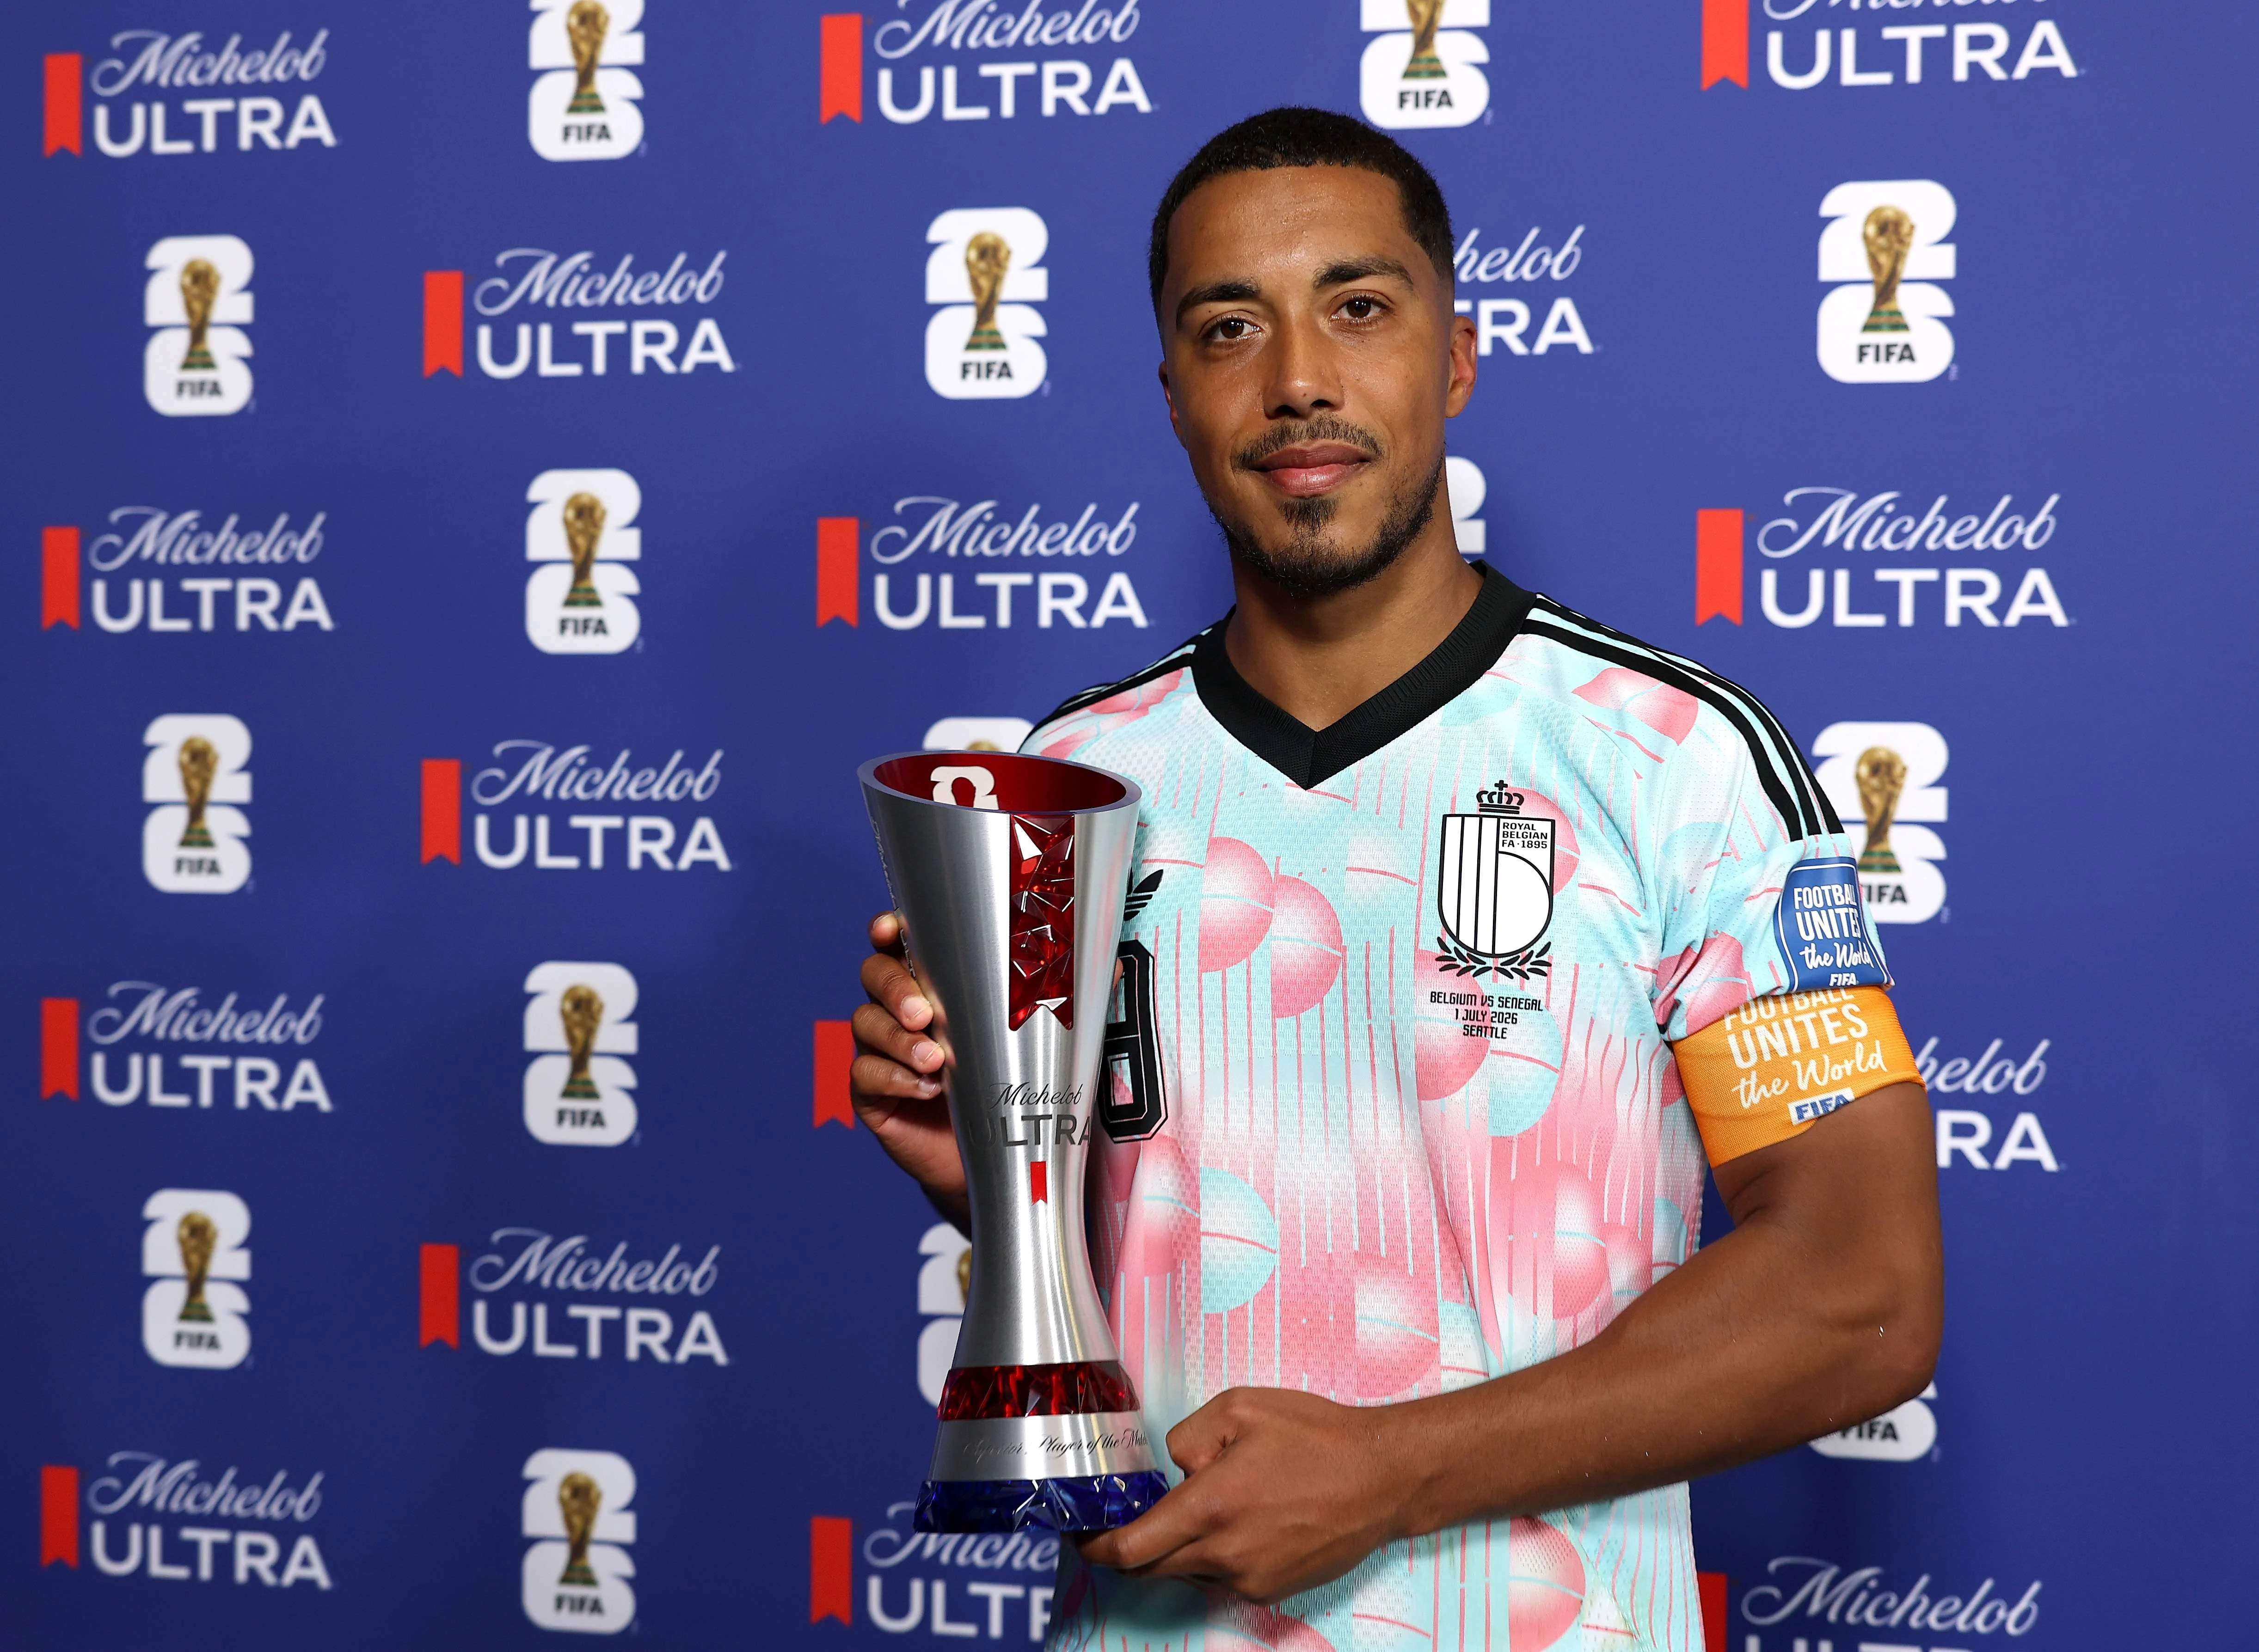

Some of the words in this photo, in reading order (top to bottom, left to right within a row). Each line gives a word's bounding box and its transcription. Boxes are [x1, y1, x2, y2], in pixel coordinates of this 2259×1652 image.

[875, 0, 1139, 58] Michelob
[1768, 19, 2077, 89] ULTRA
[92, 30, 328, 95] Michelob
[878, 57, 1151, 123] ULTRA
[95, 96, 336, 157] ULTRA
[1399, 90, 1453, 109] FIFA
[563, 124, 611, 141] FIFA
[474, 249, 726, 315] Michelob
[478, 319, 735, 378] ULTRA
[962, 361, 1013, 379] FIFA
[1858, 343, 1915, 363] FIFA
[177, 380, 222, 396] FIFA
[89, 508, 325, 571] Michelob
[871, 498, 1139, 563] Michelob
[1758, 488, 2059, 557] Michelob
[93, 578, 333, 632] ULTRA
[875, 572, 1148, 629] ULTRA
[1762, 569, 2068, 628] ULTRA
[559, 618, 608, 635] FIFA
[472, 741, 723, 805] Michelob
[475, 815, 730, 870] ULTRA
[1502, 831, 1547, 839] BELGIAN
[1503, 822, 1536, 831] ROYAL
[175, 858, 221, 874] FIFA
[1861, 883, 1907, 904] IFA
[1799, 942, 1834, 969] the
[1834, 940, 1874, 968] World
[1829, 973, 1857, 986] FIFA
[89, 982, 324, 1044] Michelob
[1430, 991, 1477, 1006] BELGIUM
[1480, 995, 1494, 1007] VS
[1498, 996, 1544, 1011] SENEGAL
[1455, 1009, 1459, 1020] 1
[1462, 1009, 1487, 1022] JULY
[1491, 1011, 1518, 1024] 2026
[1462, 1024, 1508, 1040] SEATTLE
[1727, 1003, 1868, 1069] UNITES
[92, 1053, 331, 1112] ULTRA
[989, 1082, 1083, 1109] Michelob
[1731, 1070, 1790, 1108] the
[1792, 1039, 1888, 1091] World
[557, 1109, 605, 1127] FIFA
[1794, 1094, 1850, 1120] FIFA
[471, 1229, 719, 1295] Michelob
[175, 1332, 220, 1350] FIFA
[474, 1301, 728, 1365] ULTRA
[1038, 1434, 1083, 1459] Player
[1087, 1434, 1104, 1456] of
[1102, 1433, 1119, 1449] the
[88, 1452, 323, 1521] Michelob
[92, 1522, 331, 1589] ULTRA
[555, 1595, 603, 1614] FIFA
[1742, 1557, 2042, 1636] Michelob
